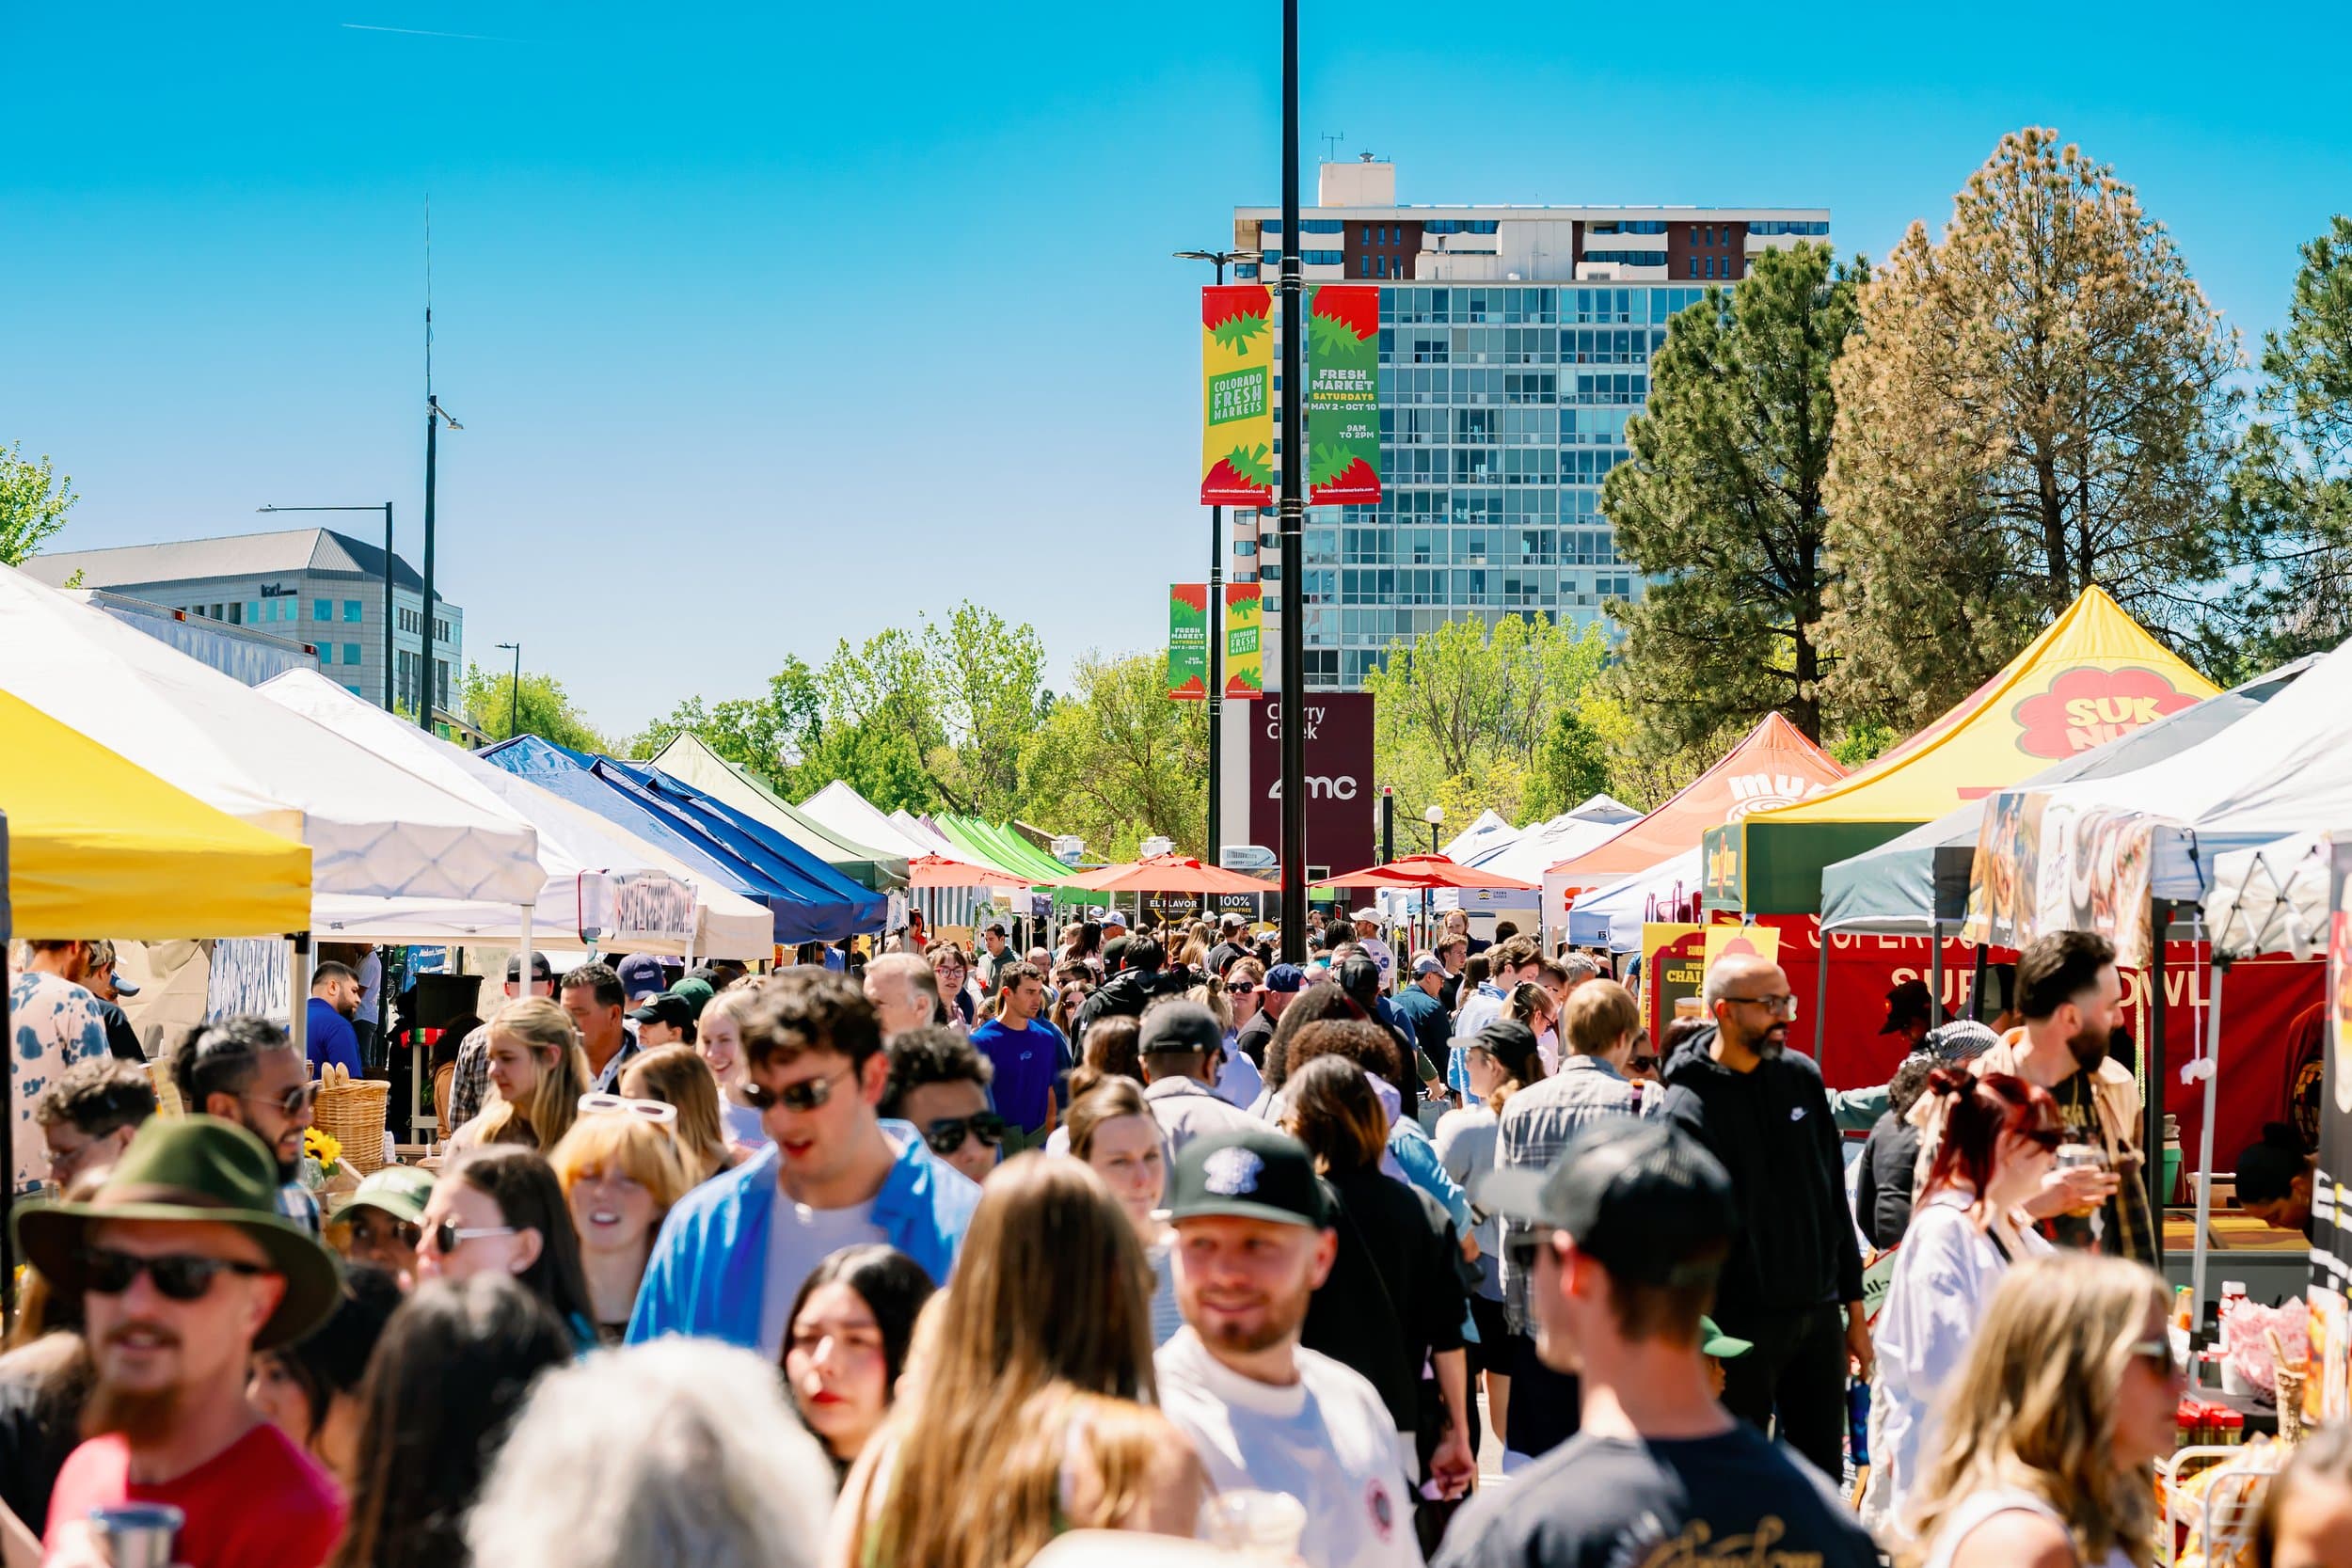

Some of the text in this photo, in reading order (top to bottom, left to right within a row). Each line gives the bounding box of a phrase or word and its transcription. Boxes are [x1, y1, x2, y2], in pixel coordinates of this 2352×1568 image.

[1319, 369, 1367, 380] FRESH
[1214, 372, 1263, 393] COLORADO
[1311, 379, 1375, 391] MARKET
[1214, 384, 1263, 409] FRESH
[1312, 392, 1375, 401] SATURDAYS
[1214, 401, 1263, 420] MARKETS
[1311, 403, 1332, 411] MAY
[1331, 403, 1339, 411] 2
[1231, 636, 1257, 649] FRESH
[1149, 899, 1161, 908] EL
[1219, 895, 1250, 907] 100%
[1666, 970, 1702, 983] CHAI
